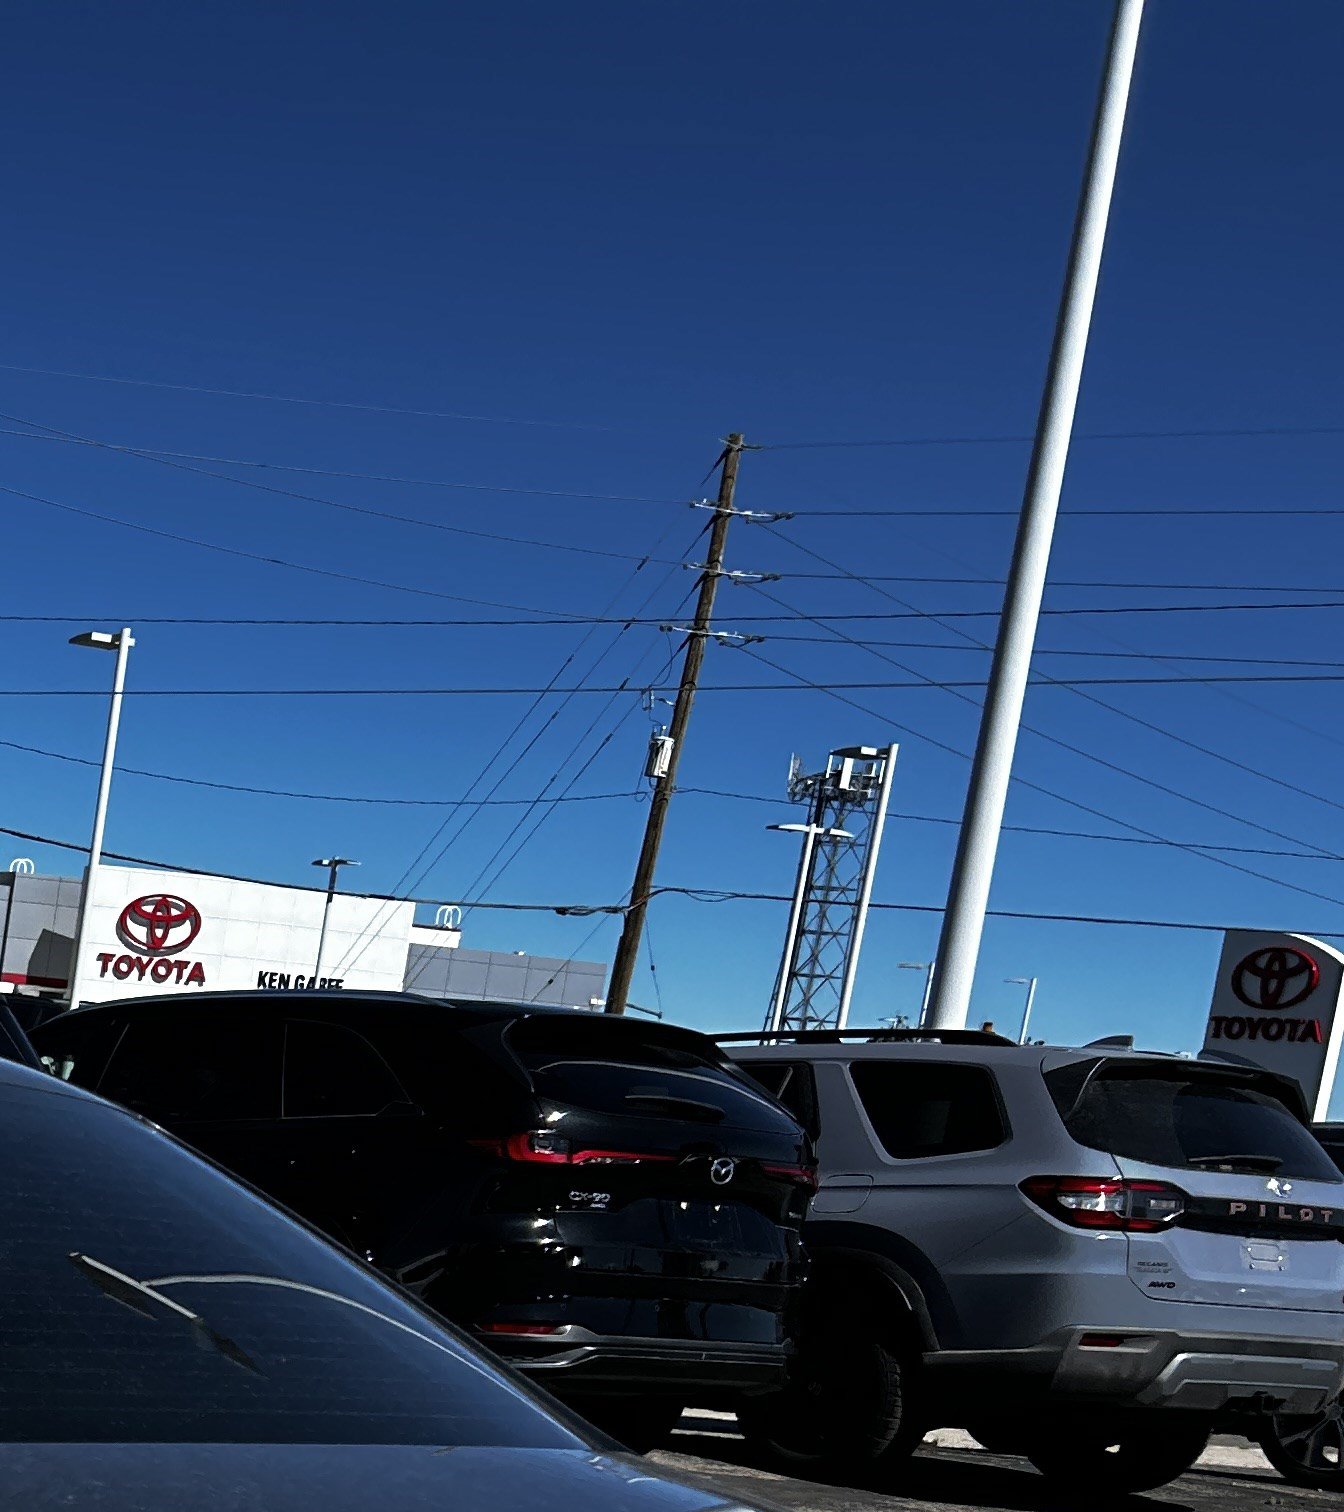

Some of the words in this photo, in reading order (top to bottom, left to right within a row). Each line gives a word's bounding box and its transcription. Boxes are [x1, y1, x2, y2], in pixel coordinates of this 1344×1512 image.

[96, 952, 205, 987] TOYOTA
[257, 970, 291, 989] KEN
[1211, 1015, 1322, 1044] TOYOTA
[1229, 1202, 1333, 1223] PILOT
